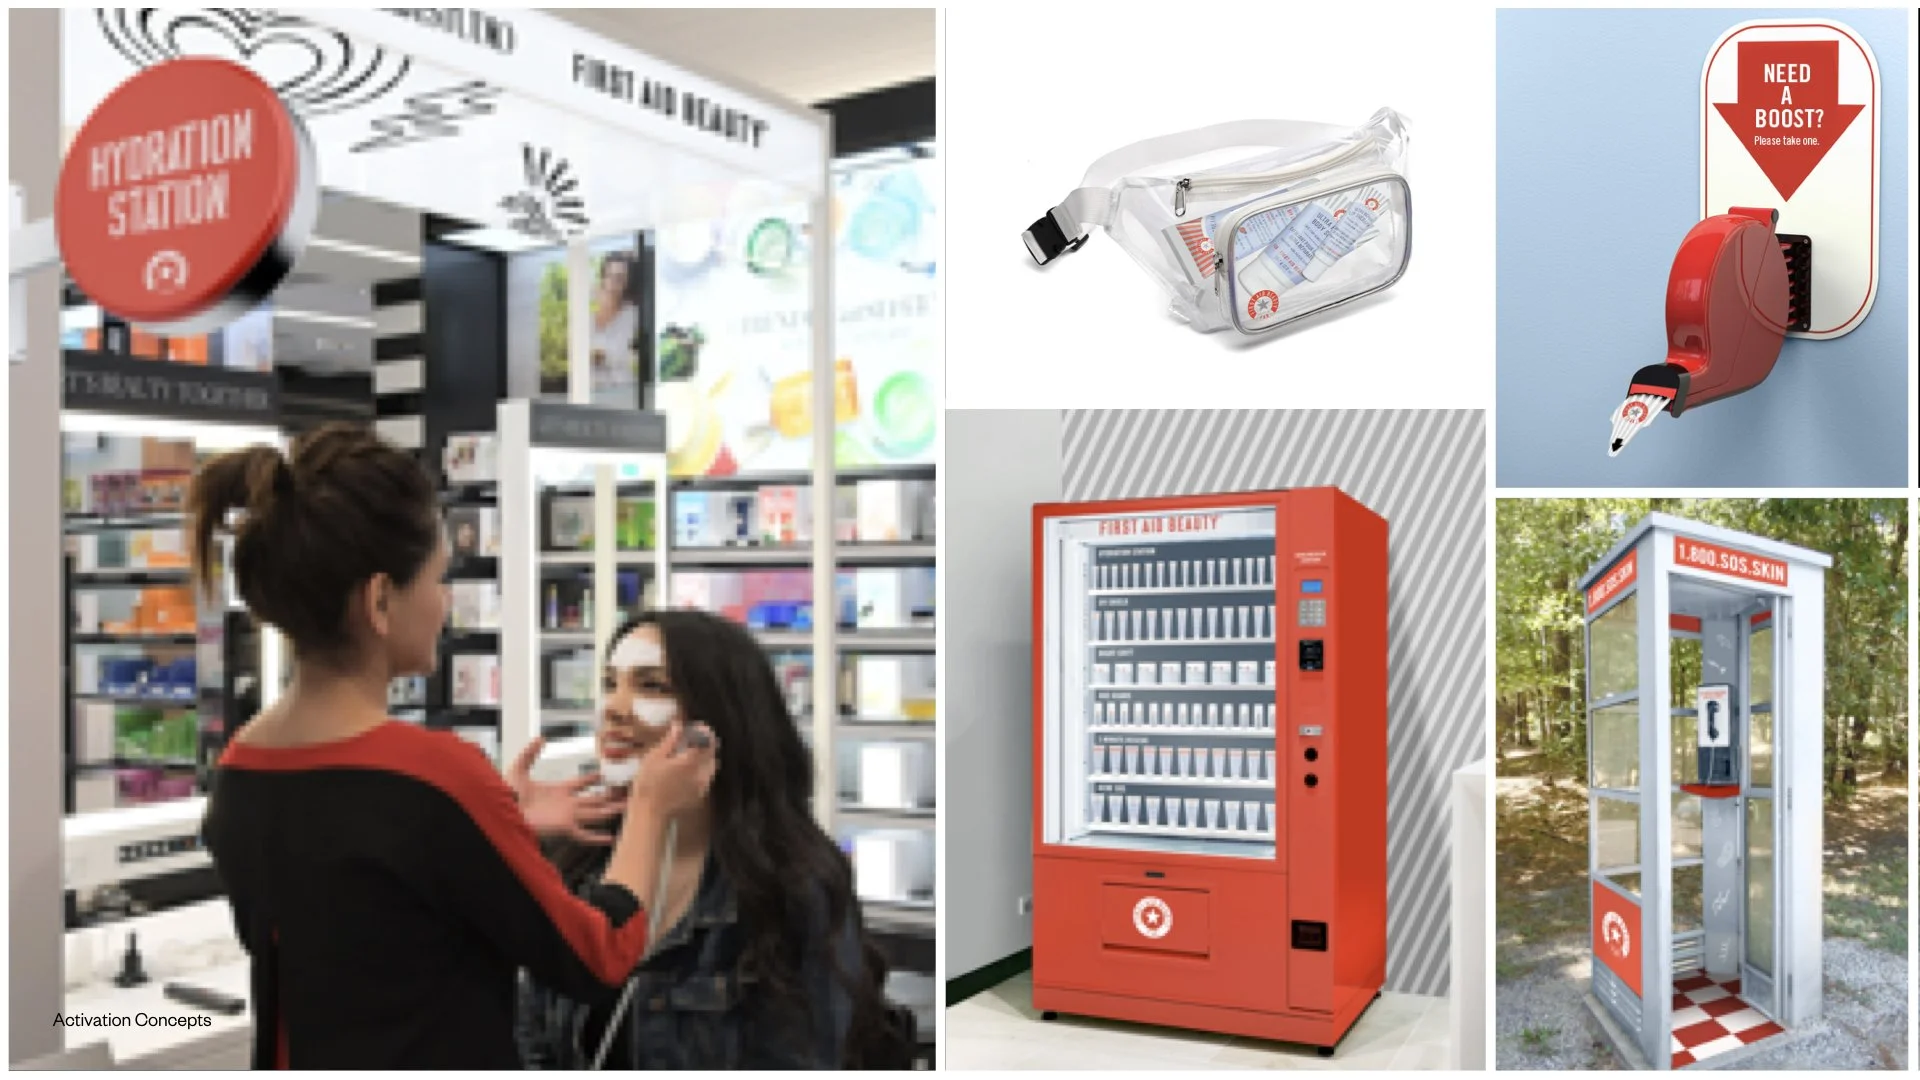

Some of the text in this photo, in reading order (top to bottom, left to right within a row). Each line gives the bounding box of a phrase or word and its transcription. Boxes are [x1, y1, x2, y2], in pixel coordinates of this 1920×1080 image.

[1764, 63, 1811, 83] NEED
[572, 53, 768, 149] FIRST AID BEAUTY
[1781, 86, 1793, 105] A
[1755, 108, 1824, 128] BOOST?
[90, 109, 256, 191] HYDRATION
[1754, 135, 1820, 146] Please take one.
[107, 169, 231, 238] STATION
[1099, 514, 1219, 536] FIRST AID BEAUTY
[1679, 543, 1784, 582] 1.800.SOS.SKIN
